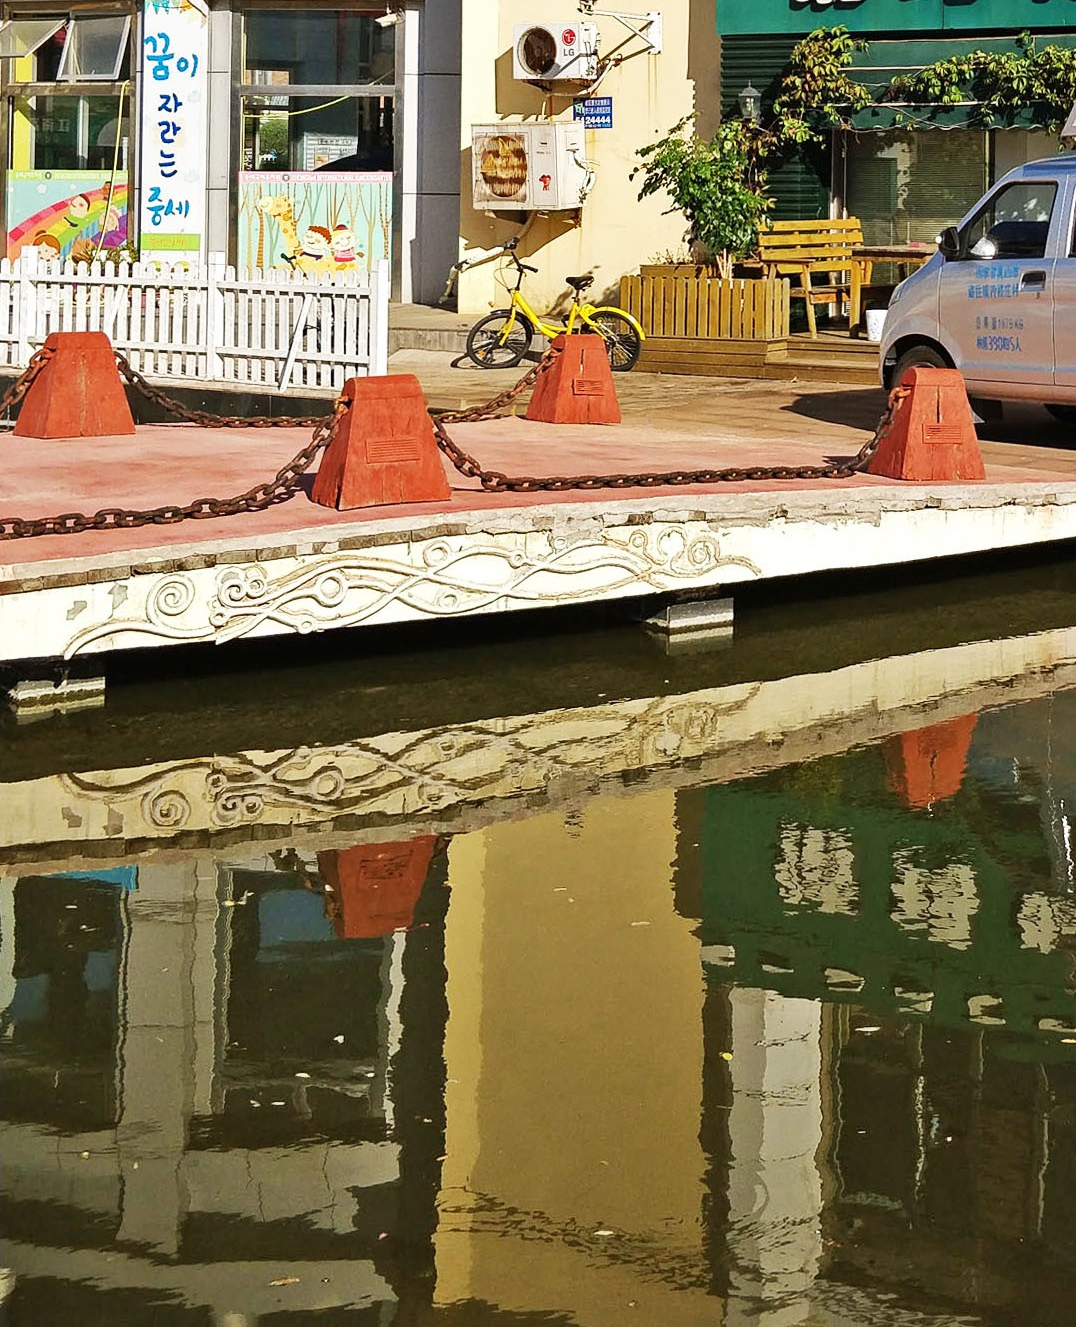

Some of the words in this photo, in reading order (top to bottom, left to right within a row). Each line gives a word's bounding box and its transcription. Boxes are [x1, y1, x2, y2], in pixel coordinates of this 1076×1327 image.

[144, 32, 198, 80] 꿈이
[563, 48, 575, 57] LG
[158, 93, 183, 178] 자라는
[147, 187, 190, 226] 중세
